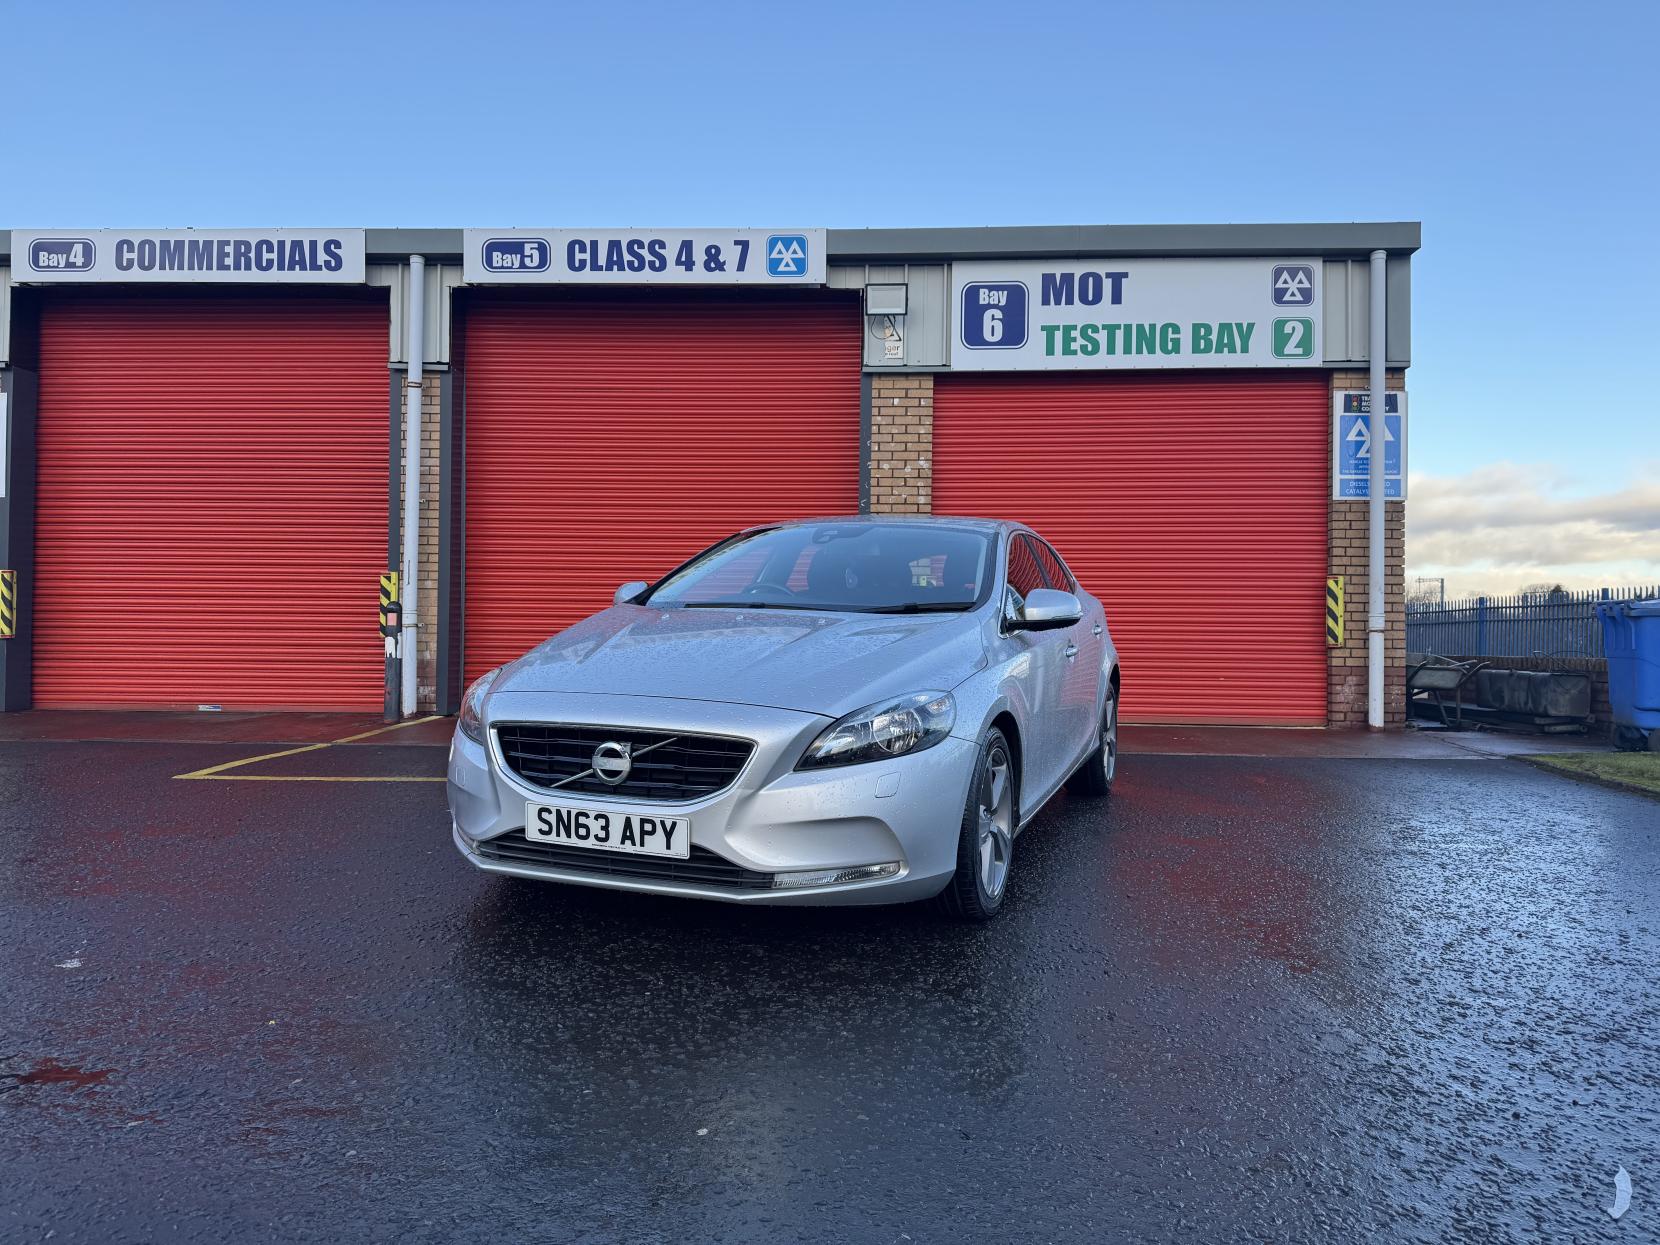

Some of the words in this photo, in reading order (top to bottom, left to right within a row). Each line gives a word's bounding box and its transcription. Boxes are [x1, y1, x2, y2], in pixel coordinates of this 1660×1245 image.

[38, 250, 66, 269] Bay
[68, 243, 85, 265] 4
[114, 238, 344, 272] COMMERCIALS
[491, 250, 521, 270] Bay
[523, 242, 540, 266] 5
[566, 239, 668, 273] CLASS
[674, 239, 696, 272] 4
[703, 244, 727, 273] &
[733, 239, 751, 272] 7
[978, 288, 1008, 306] Bay
[1040, 271, 1129, 307] MOT
[982, 308, 1004, 343] 6
[1040, 321, 1181, 357] TESTING
[1191, 321, 1256, 355] BAY
[1282, 319, 1304, 357] 2
[536, 806, 610, 843] SN63
[620, 816, 678, 851] APY
